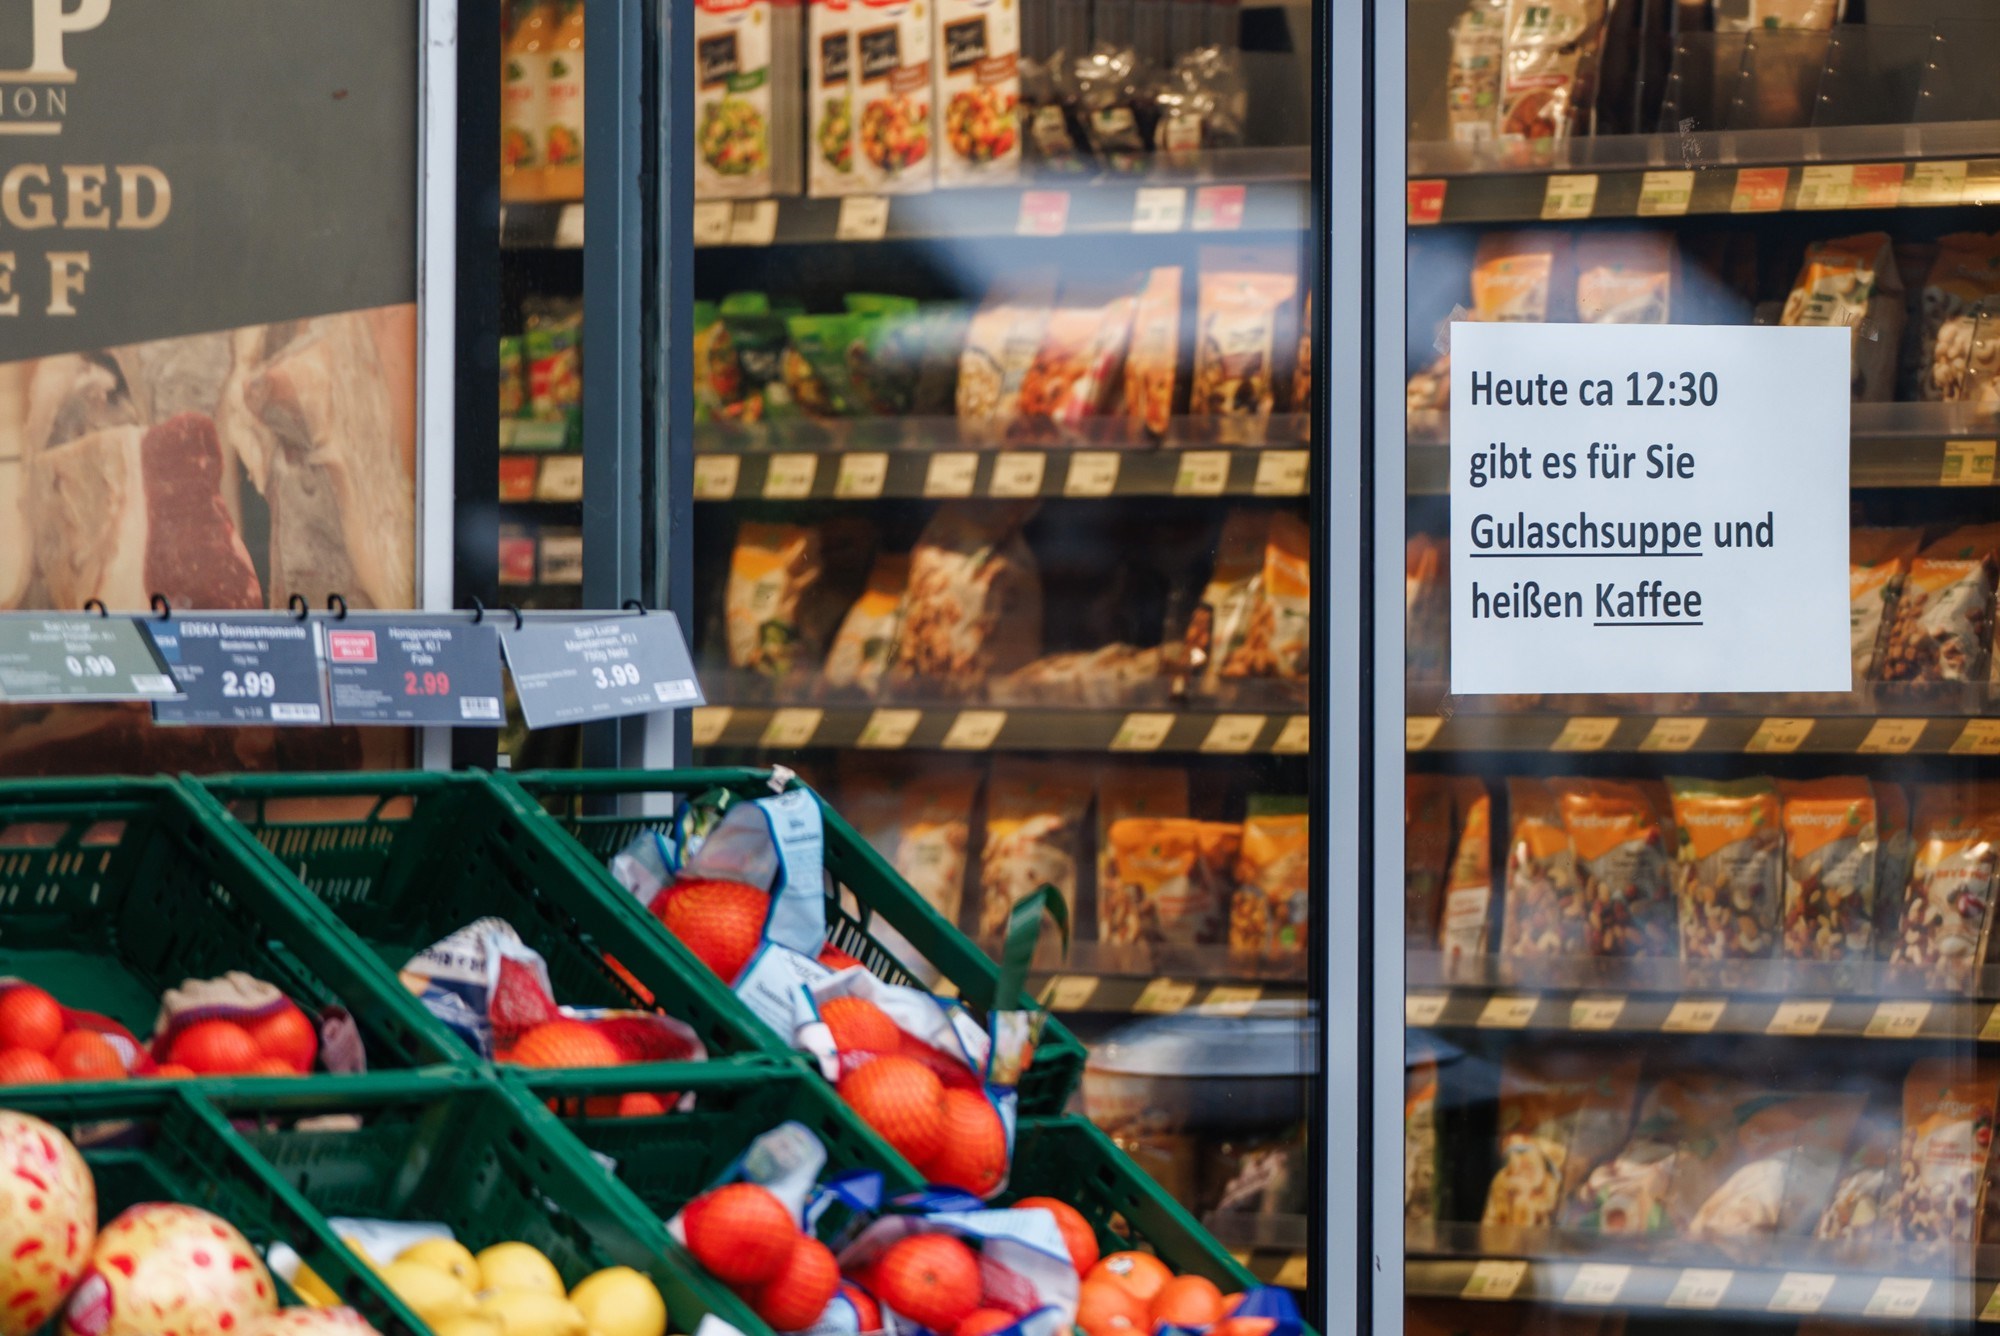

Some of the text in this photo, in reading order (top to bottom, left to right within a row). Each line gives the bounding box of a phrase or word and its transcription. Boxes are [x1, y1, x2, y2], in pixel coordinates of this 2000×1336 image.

[2, 163, 172, 230] GED
[1470, 370, 1718, 407] Heute ca 12:30
[1469, 441, 1695, 488] gibt es für Sie
[1470, 510, 1774, 555] Gulaschsuppe und
[1472, 580, 1702, 619] heißen Kaffee
[180, 621, 219, 638] EDEKA
[65, 654, 117, 678] 0.99
[592, 662, 641, 690] 3.99
[222, 671, 276, 698] 2.99
[404, 670, 450, 696] 2.99
